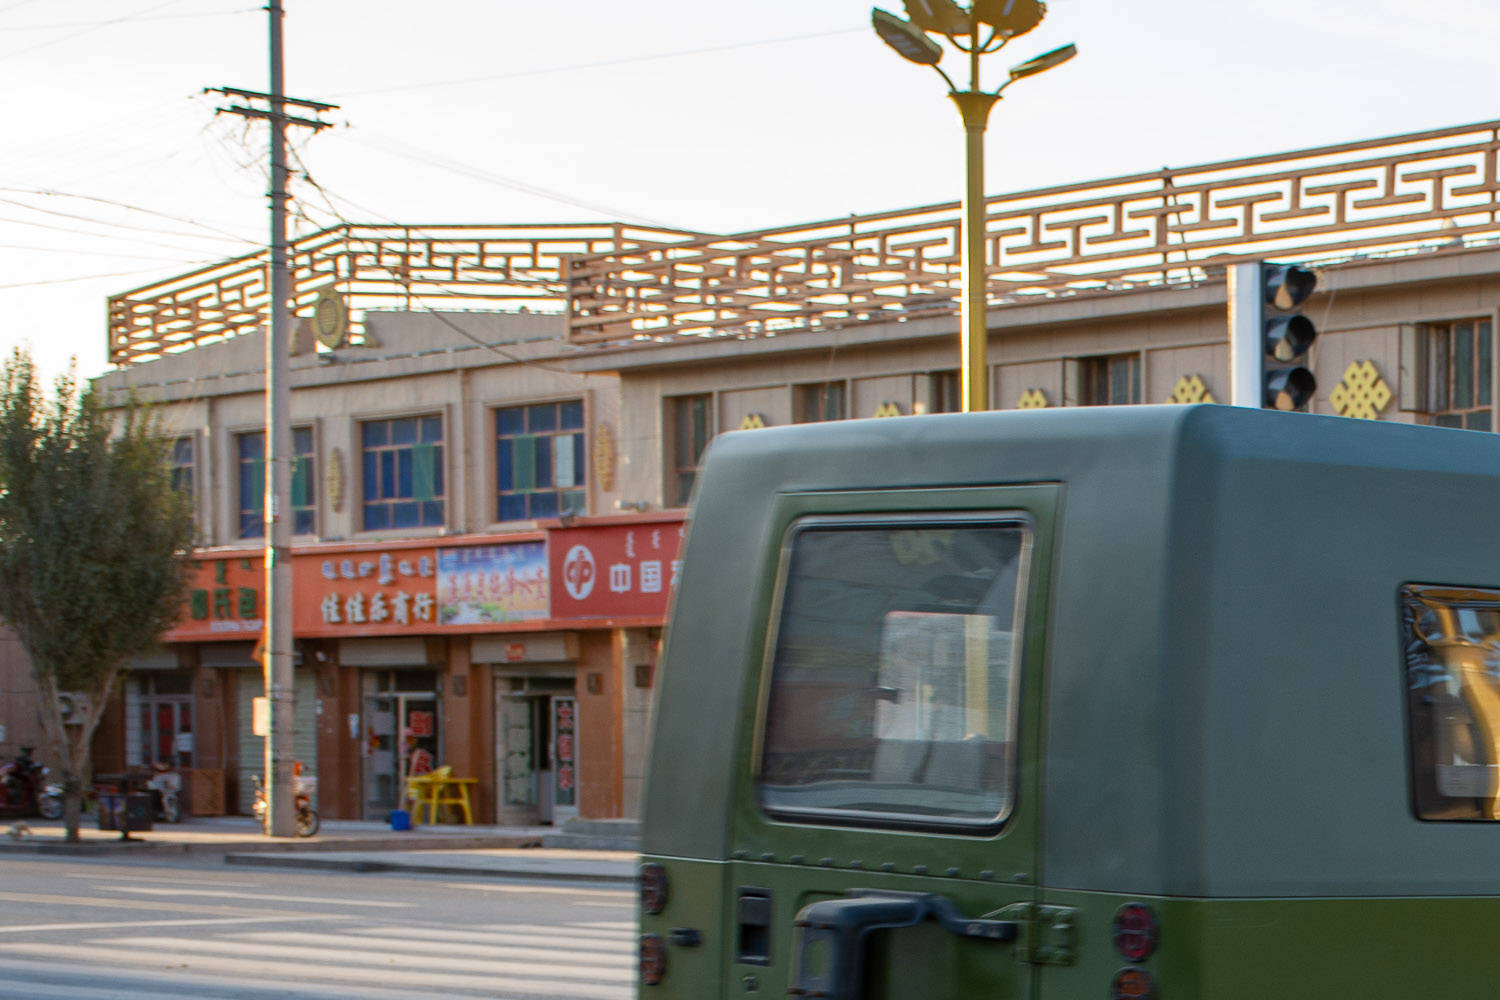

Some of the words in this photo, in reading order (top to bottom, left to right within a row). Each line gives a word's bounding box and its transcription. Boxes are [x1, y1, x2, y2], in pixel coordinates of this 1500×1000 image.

[321, 591, 434, 627] 佳佳乐商行
